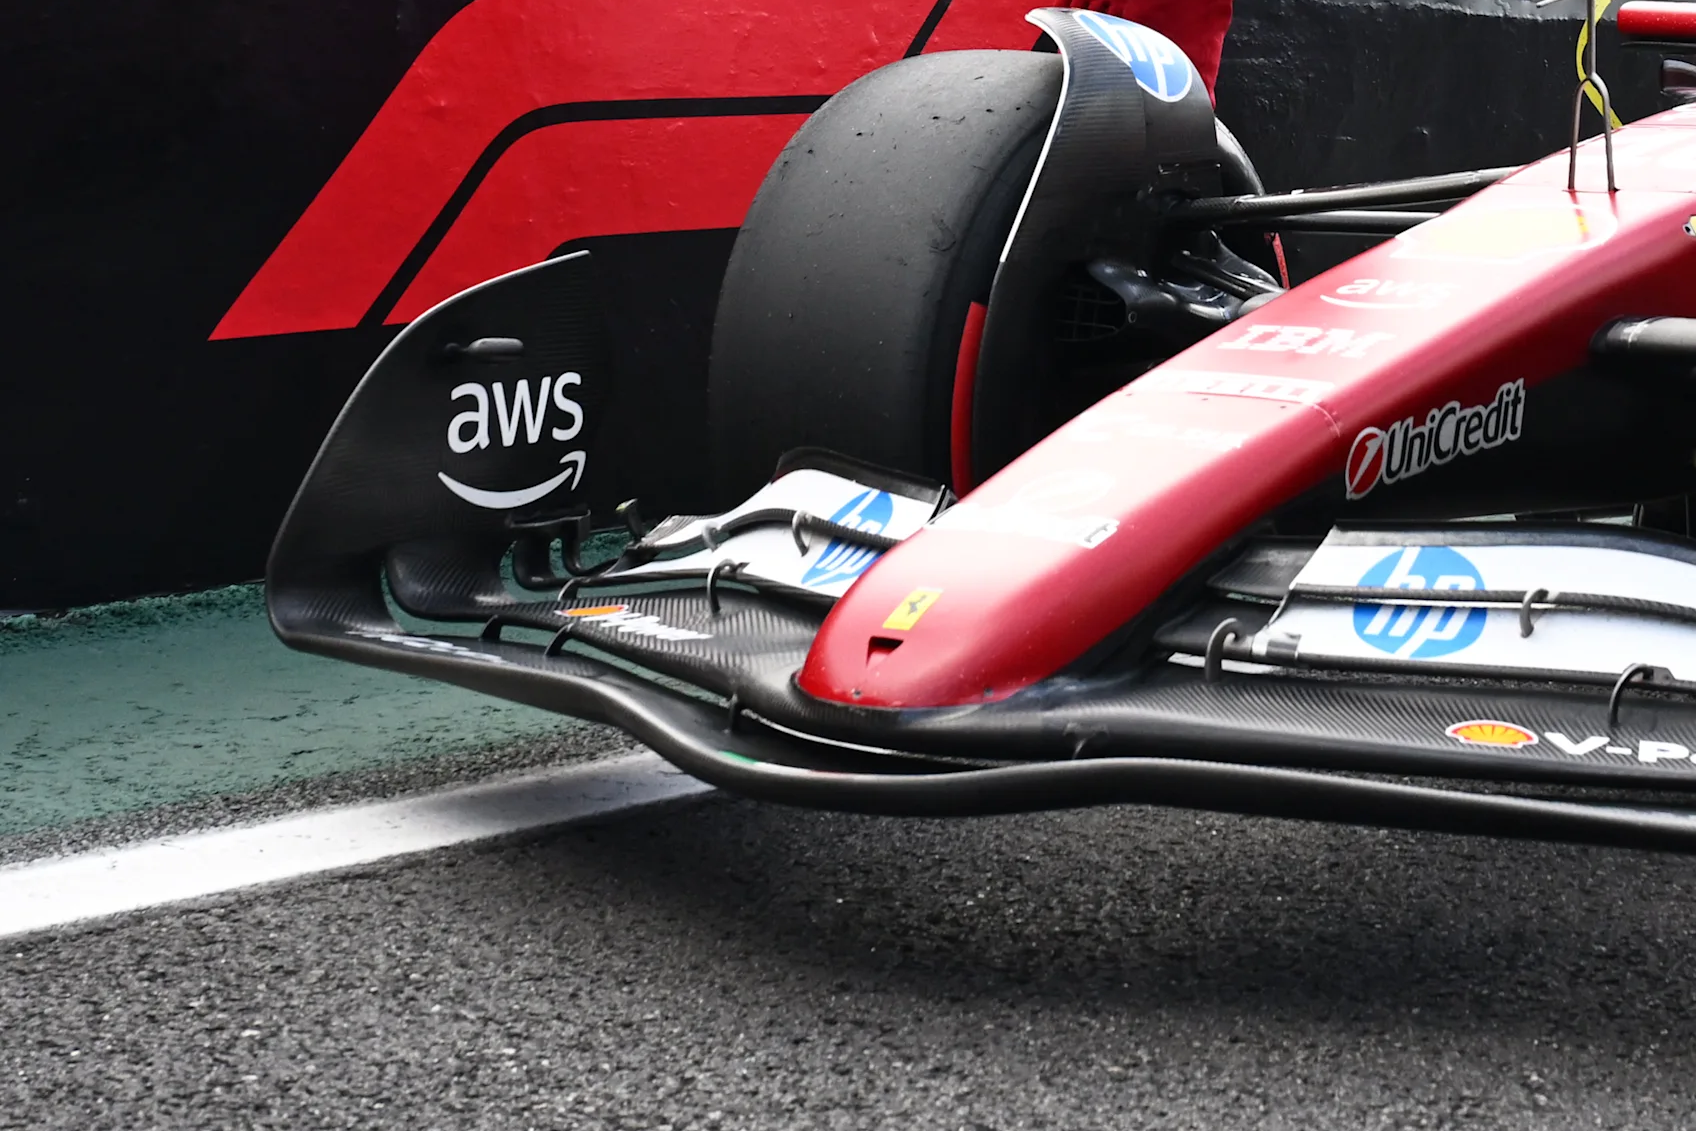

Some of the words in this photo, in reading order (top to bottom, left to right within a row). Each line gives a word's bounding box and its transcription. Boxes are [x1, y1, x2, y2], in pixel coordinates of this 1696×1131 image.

[1080, 13, 1180, 100] hp
[1336, 277, 1462, 300] aws
[1216, 324, 1397, 359] IBM
[447, 372, 585, 455] aws
[1388, 378, 1526, 480] UniCredit
[1362, 547, 1478, 657] hp
